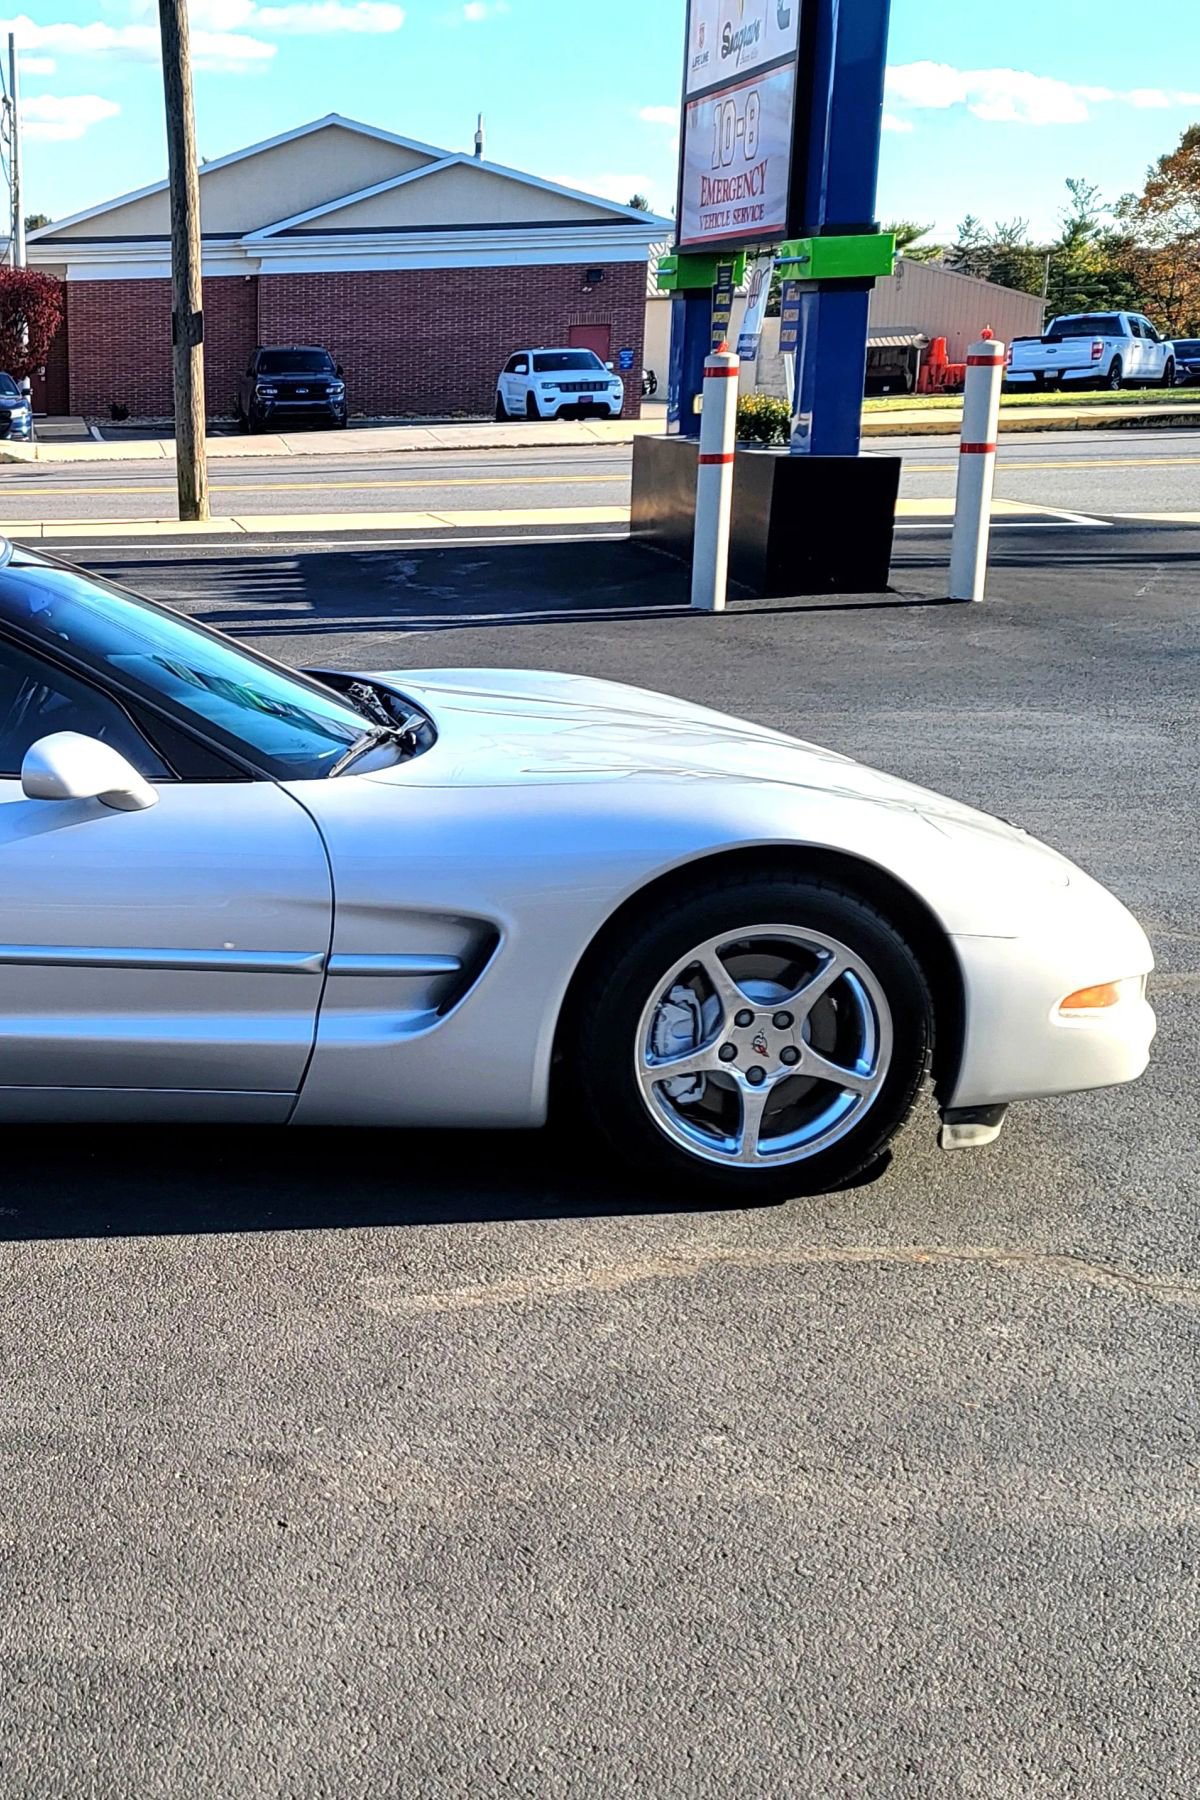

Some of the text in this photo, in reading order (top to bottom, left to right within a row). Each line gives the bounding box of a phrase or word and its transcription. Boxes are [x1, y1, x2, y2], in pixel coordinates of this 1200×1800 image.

[712, 90, 760, 170] 10-8
[700, 158, 768, 208] EMERGENCY
[700, 203, 765, 230] VEHICLE SERVICE
